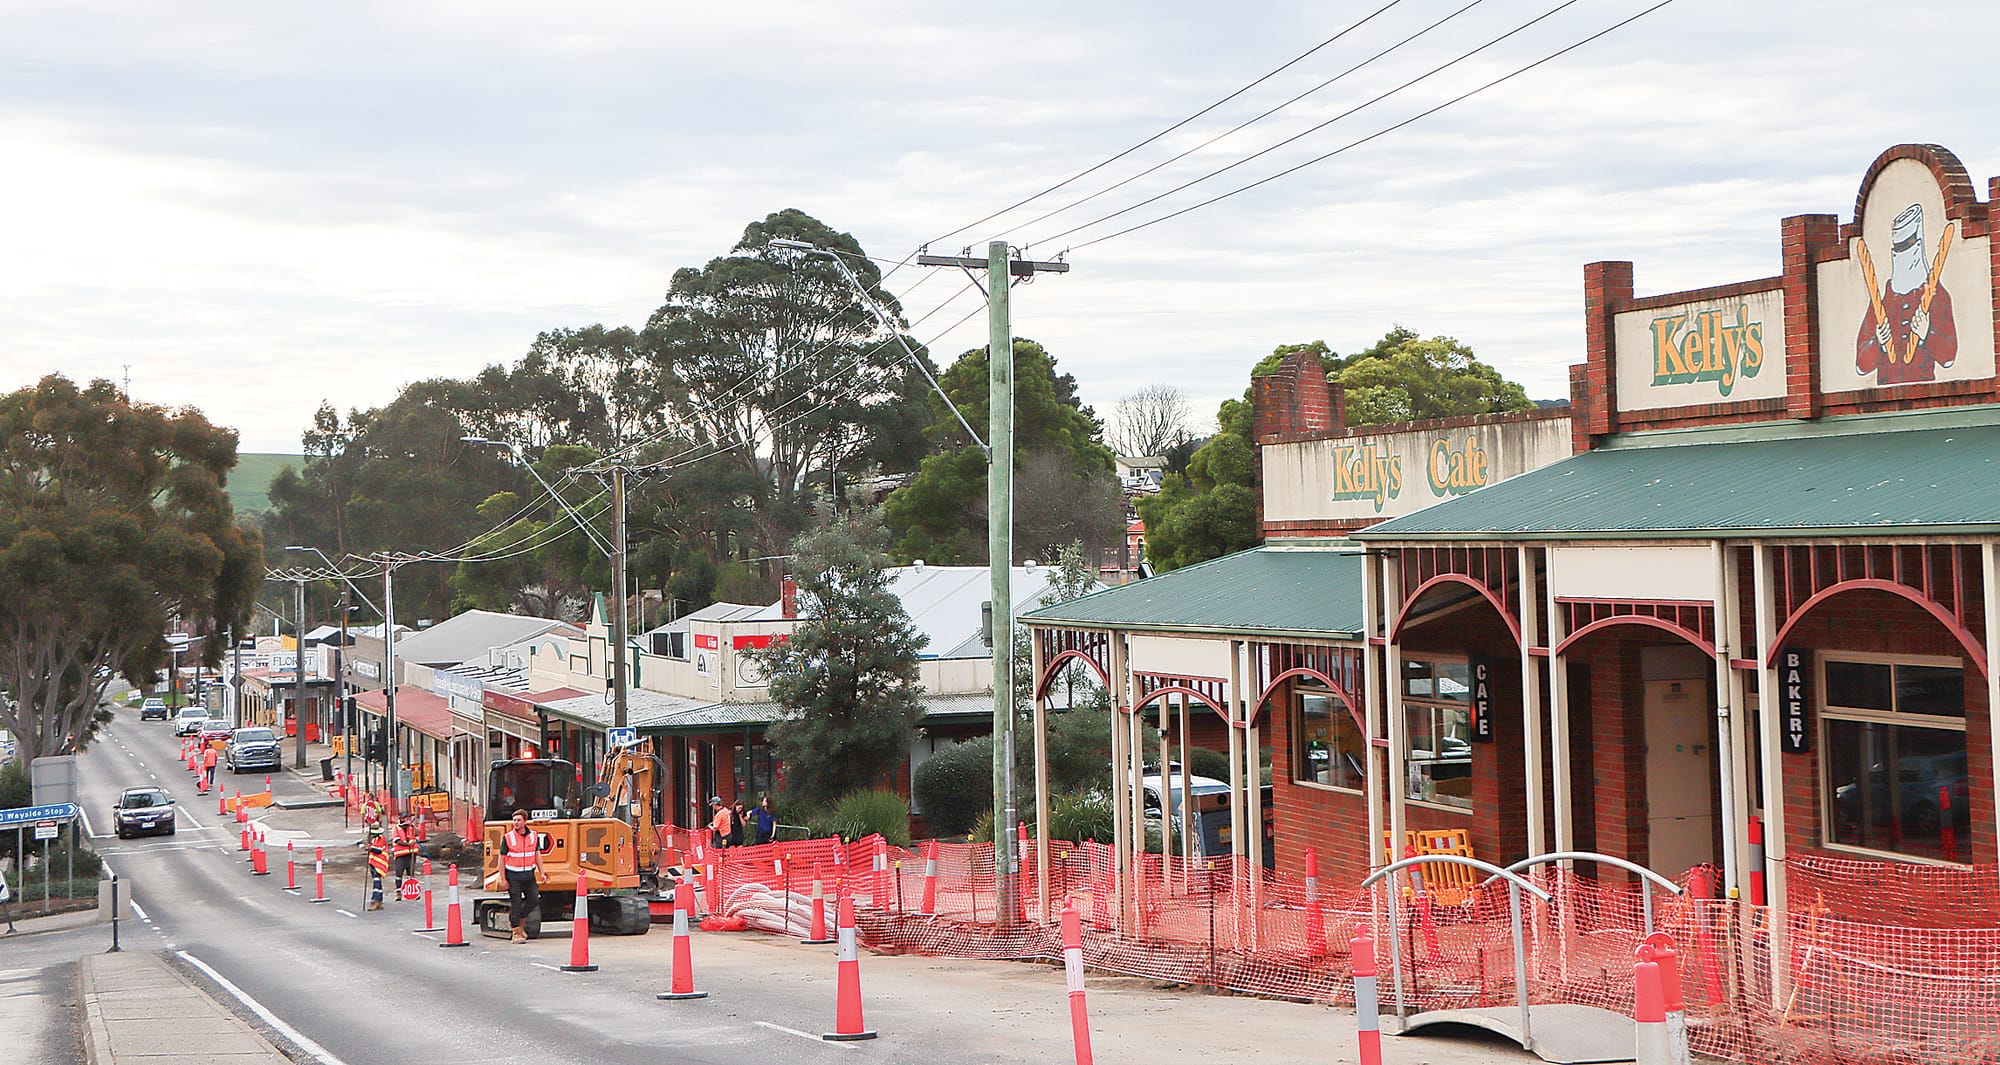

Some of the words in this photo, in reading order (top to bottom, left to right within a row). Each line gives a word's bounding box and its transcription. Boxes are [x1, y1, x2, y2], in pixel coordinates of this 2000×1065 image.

[1650, 303, 1763, 394] Kelly's
[1332, 440, 1402, 512] Kelly's
[1427, 434, 1487, 497] Cafe
[272, 656, 314, 666] FLORST
[1476, 664, 1489, 735] CAFE
[1787, 653, 1803, 748] BAKERY
[7, 811, 42, 820] Wayside
[45, 808, 64, 816] Stop
[402, 883, 421, 896] STOP
